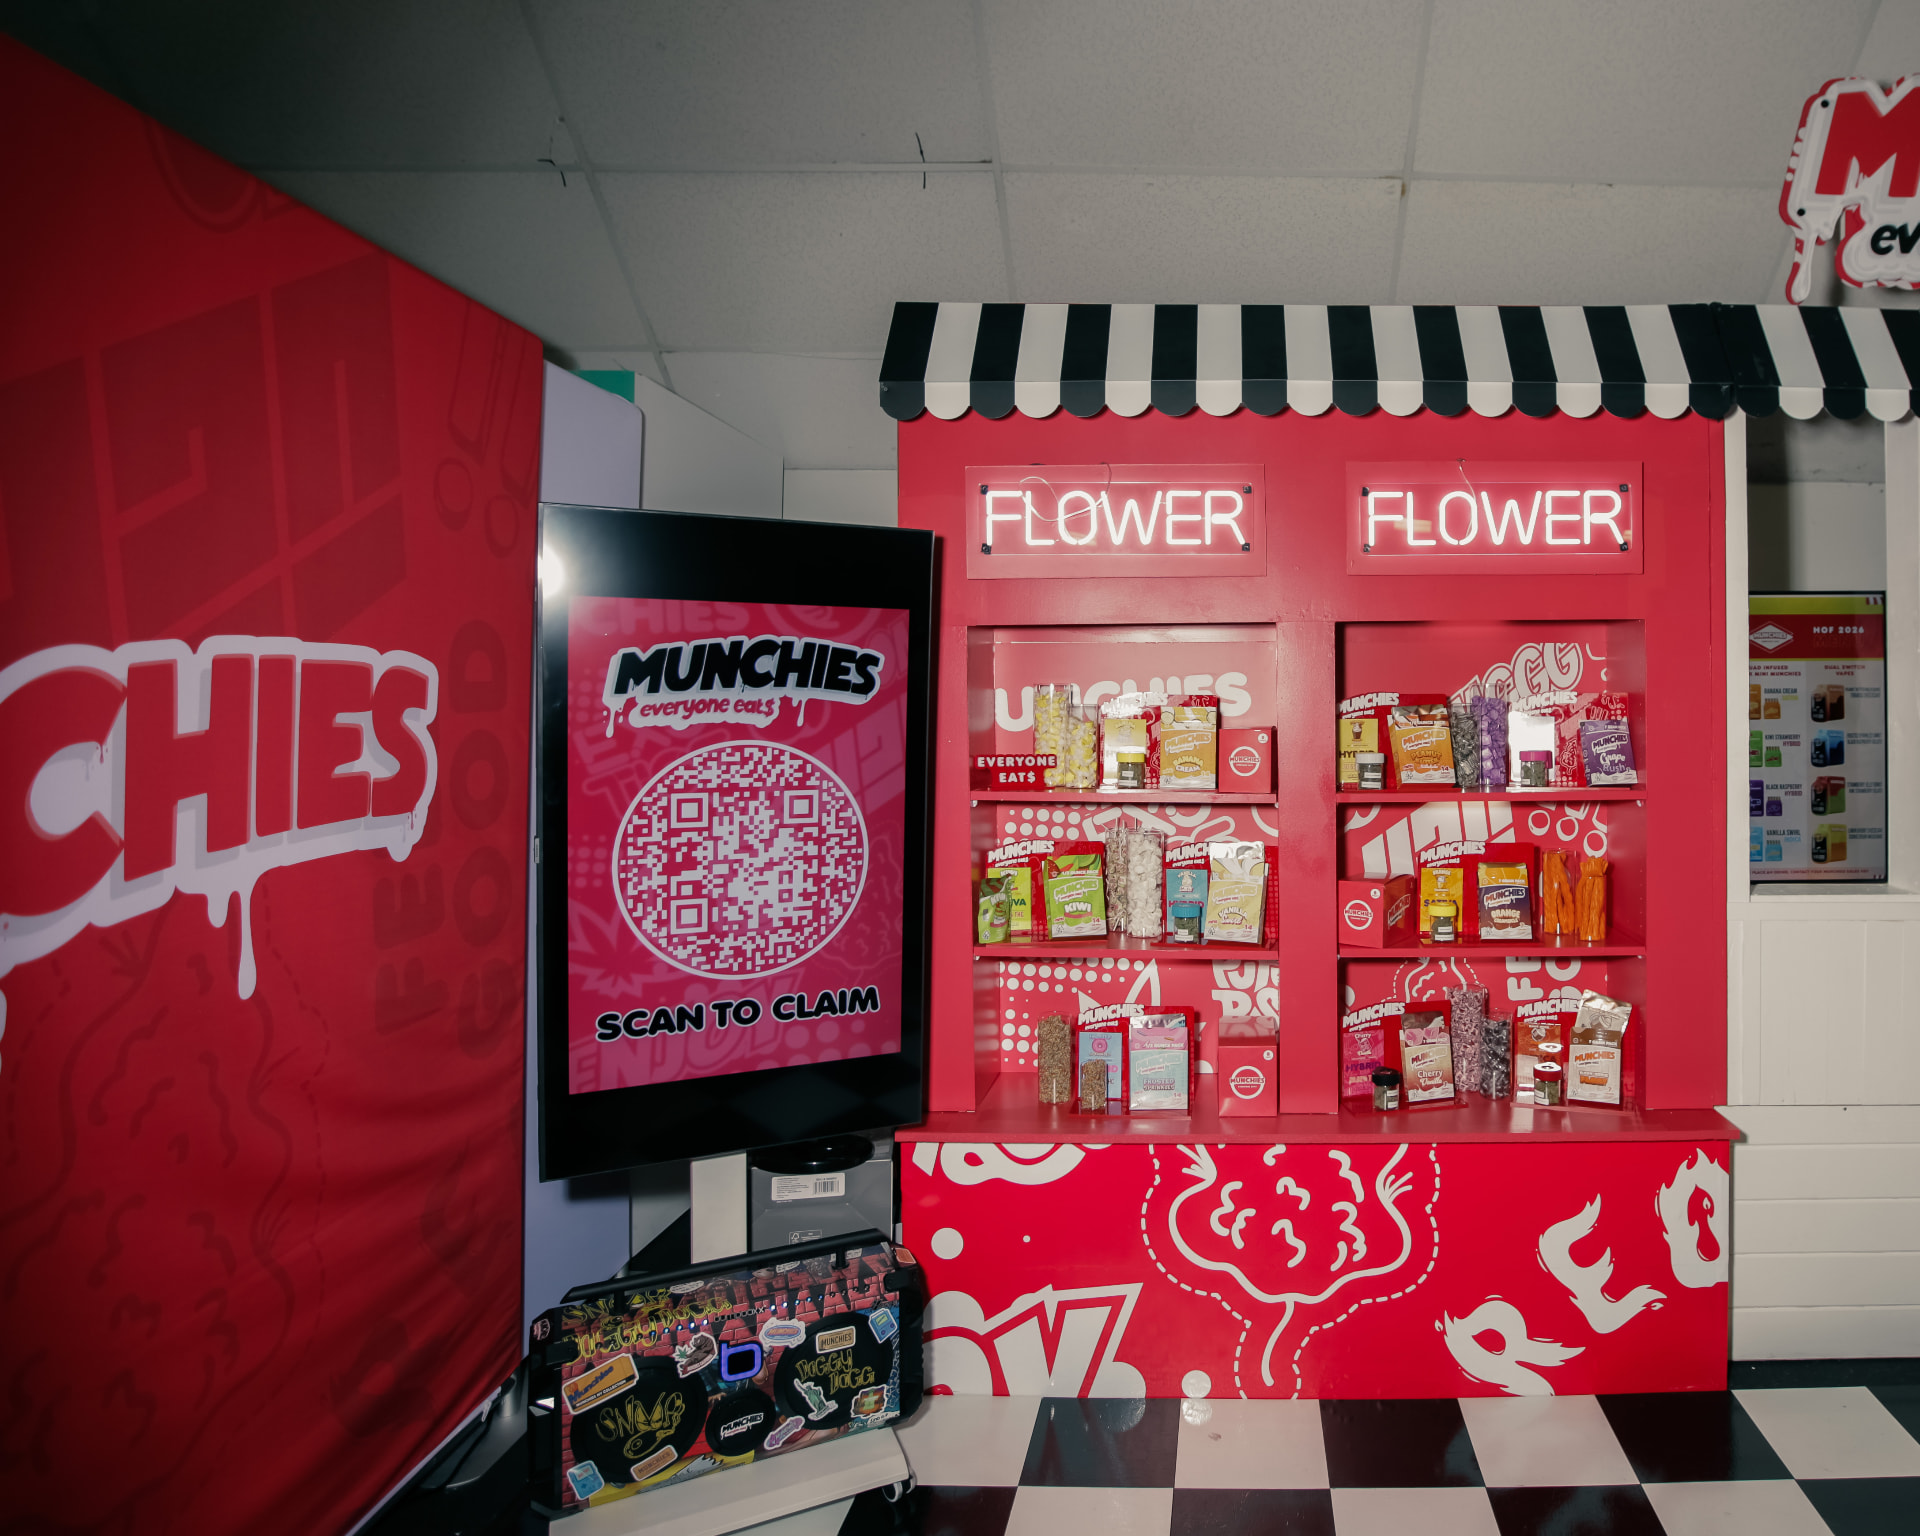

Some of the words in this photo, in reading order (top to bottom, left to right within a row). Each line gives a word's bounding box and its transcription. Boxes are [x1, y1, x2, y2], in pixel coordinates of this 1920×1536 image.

[984, 490, 1246, 547] FLOWER
[1366, 490, 1626, 547] FLOWER
[1812, 626, 1834, 634] HOF
[1838, 626, 1865, 634] 2026
[614, 639, 880, 697] MUNCHIES
[640, 698, 731, 719] everyone
[977, 756, 1056, 768] EVERYONE
[988, 840, 1055, 863] MUNCHIES
[1420, 841, 1486, 863] MUNCHIES
[1485, 888, 1525, 904] MUNCHIES
[1064, 902, 1092, 913] KIWI
[1491, 908, 1521, 918] ORANGE
[597, 1004, 704, 1041] SCAN
[711, 999, 762, 1028] TO
[772, 986, 880, 1020] CLAIM
[1078, 1003, 1145, 1025] MUNCHIES
[1343, 1002, 1406, 1028] MUNCHIES
[1574, 1051, 1615, 1062] MUNCHIES
[1418, 1070, 1443, 1080] Cherry
[820, 1332, 853, 1347] MUNCHIES
[794, 1348, 854, 1383] DOGGY
[602, 1379, 627, 1394] COLLECTION
[829, 1365, 876, 1396] DOGG
[722, 1414, 763, 1431] MUNCHIES
